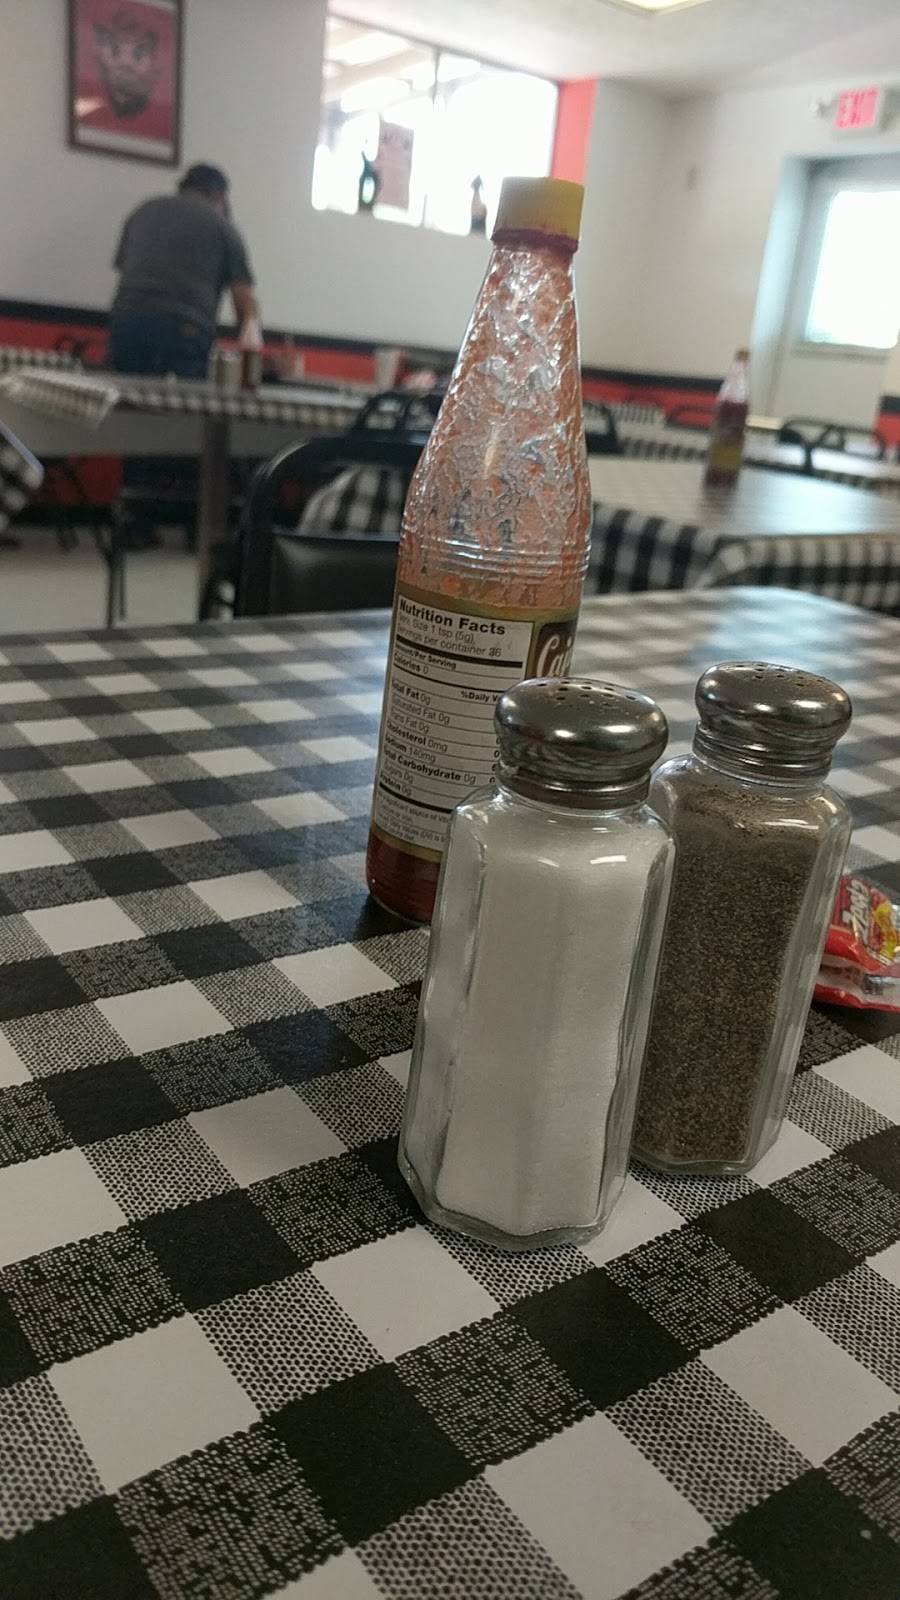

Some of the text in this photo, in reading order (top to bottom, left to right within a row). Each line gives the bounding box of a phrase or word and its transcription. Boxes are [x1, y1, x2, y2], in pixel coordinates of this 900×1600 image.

[400, 599, 505, 635] Nutrition Facts
[438, 627, 452, 640] tsp
[440, 640, 486, 656] container
[428, 656, 457, 671] Serving
[406, 687, 419, 700] Fat
[438, 712, 450, 725] 0g
[386, 719, 427, 745] Cholesterol
[398, 755, 461, 781] Carbohydrate
